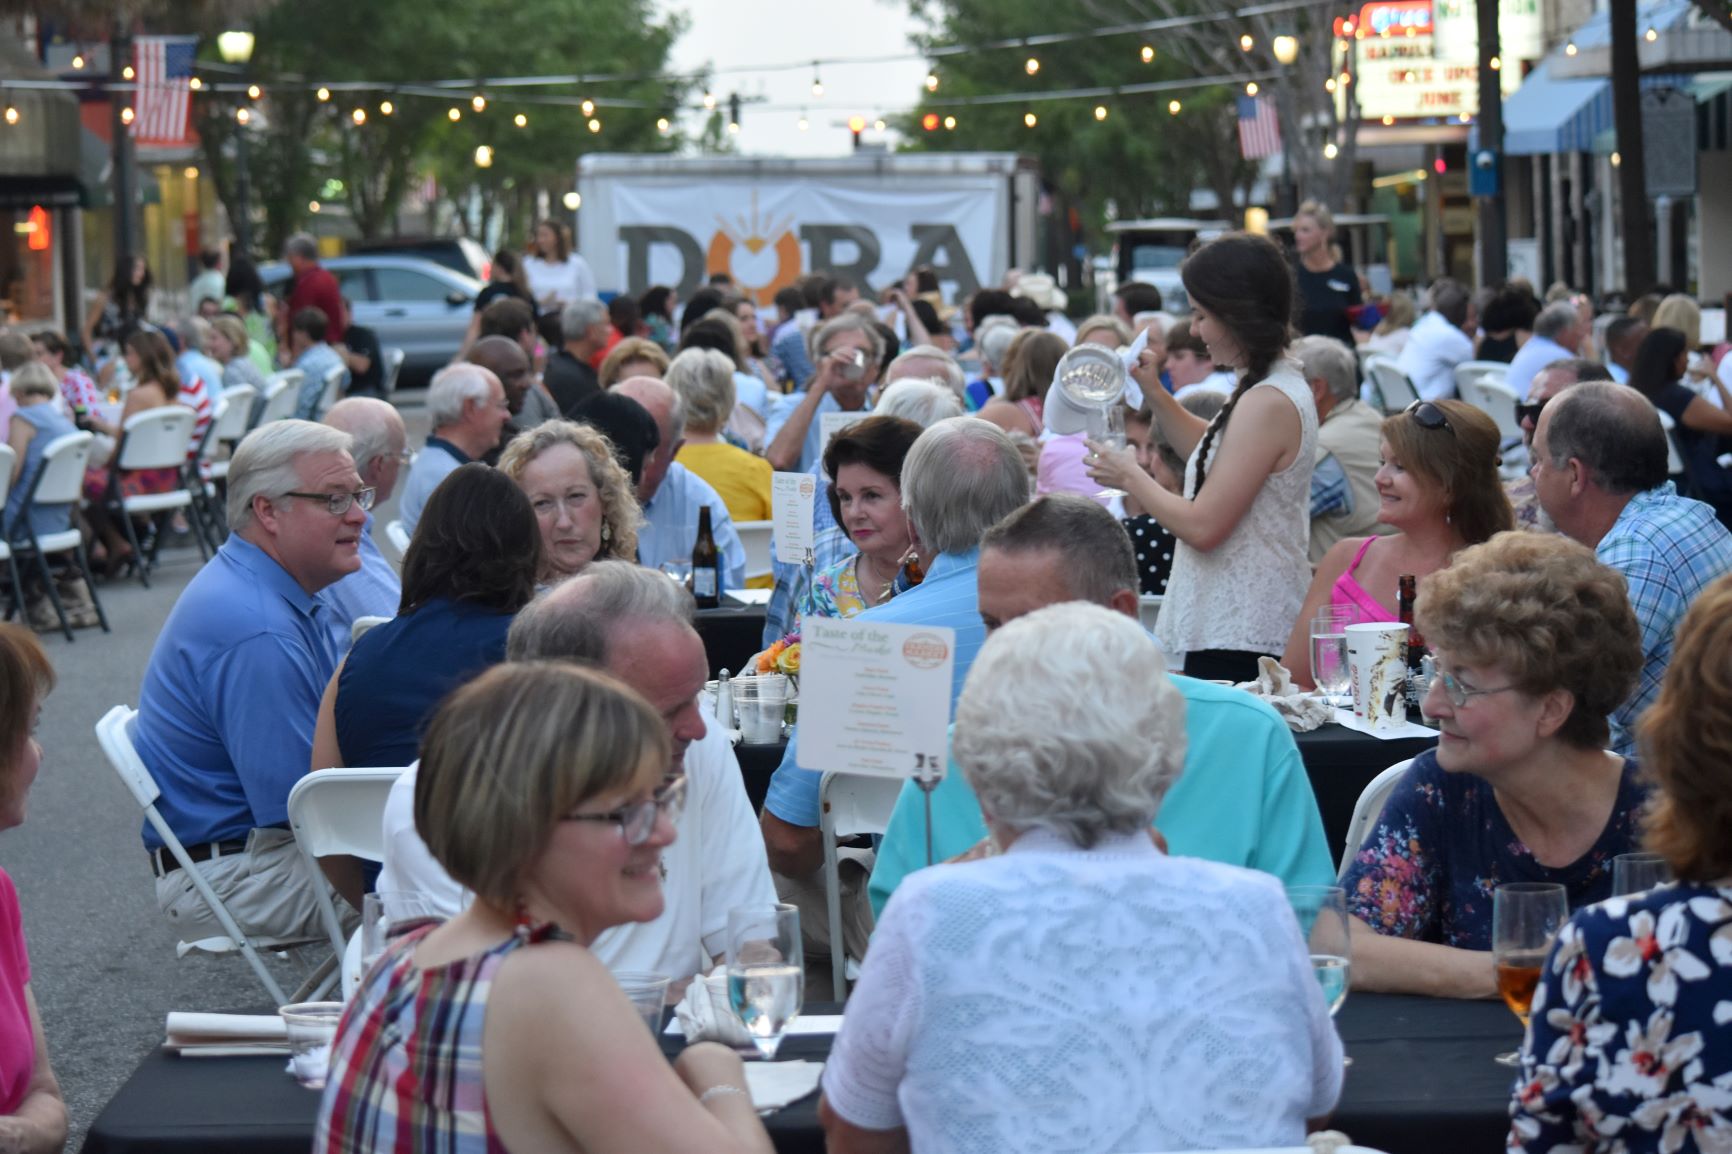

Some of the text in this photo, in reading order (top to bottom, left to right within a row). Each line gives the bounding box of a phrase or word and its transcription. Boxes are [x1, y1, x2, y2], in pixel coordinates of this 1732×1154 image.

[619, 224, 981, 306] DORA
[813, 625, 889, 643] Taste of the
